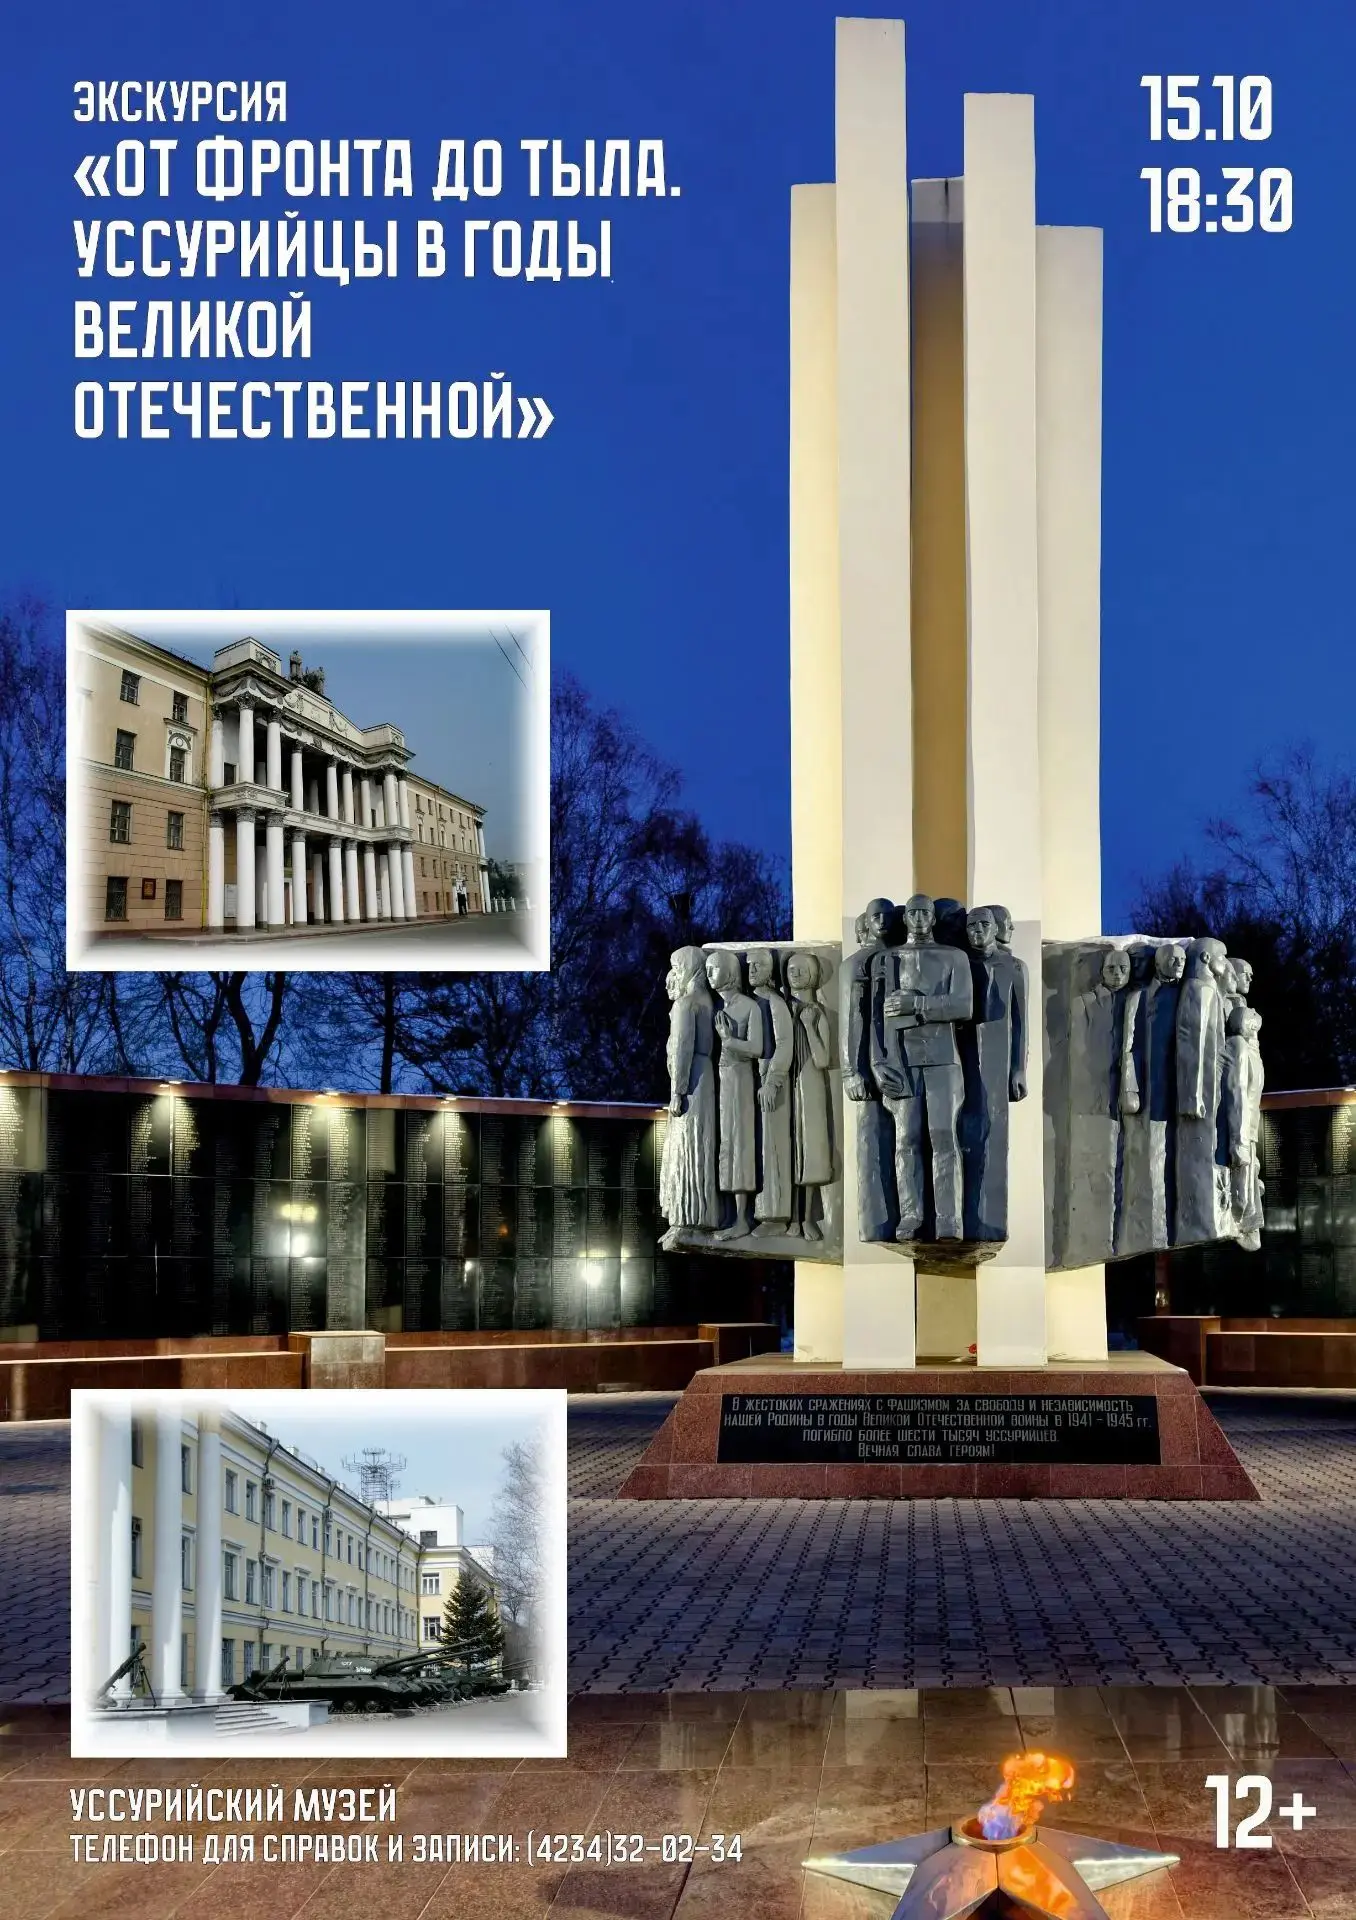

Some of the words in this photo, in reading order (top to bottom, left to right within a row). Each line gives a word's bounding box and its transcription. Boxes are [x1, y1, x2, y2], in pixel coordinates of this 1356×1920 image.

[745, 1398, 803, 1411] ЖЕСТОКИХ
[808, 1398, 871, 1411] СРАЖЕНИЯХ
[887, 1398, 950, 1411] ФАШИЗМОМ
[956, 1399, 970, 1411] ЗА
[974, 1399, 1025, 1412] СВОБОДУ
[1029, 1399, 1037, 1411] И
[1041, 1399, 1134, 1412] НЕЗАВИСИМОСТЬ
[1067, 1412, 1092, 1427] 1941
[1106, 1412, 1134, 1428] 1945
[802, 1429, 853, 1442] ПОГИБЛО
[858, 1429, 891, 1442] БОЛЕЕ
[897, 1429, 936, 1442] ШЕСТИ
[941, 1429, 980, 1442] ТЫСЯЧ
[907, 1444, 942, 1457] СЛАВА
[950, 1443, 995, 1457] ГЕРОЯМ!
